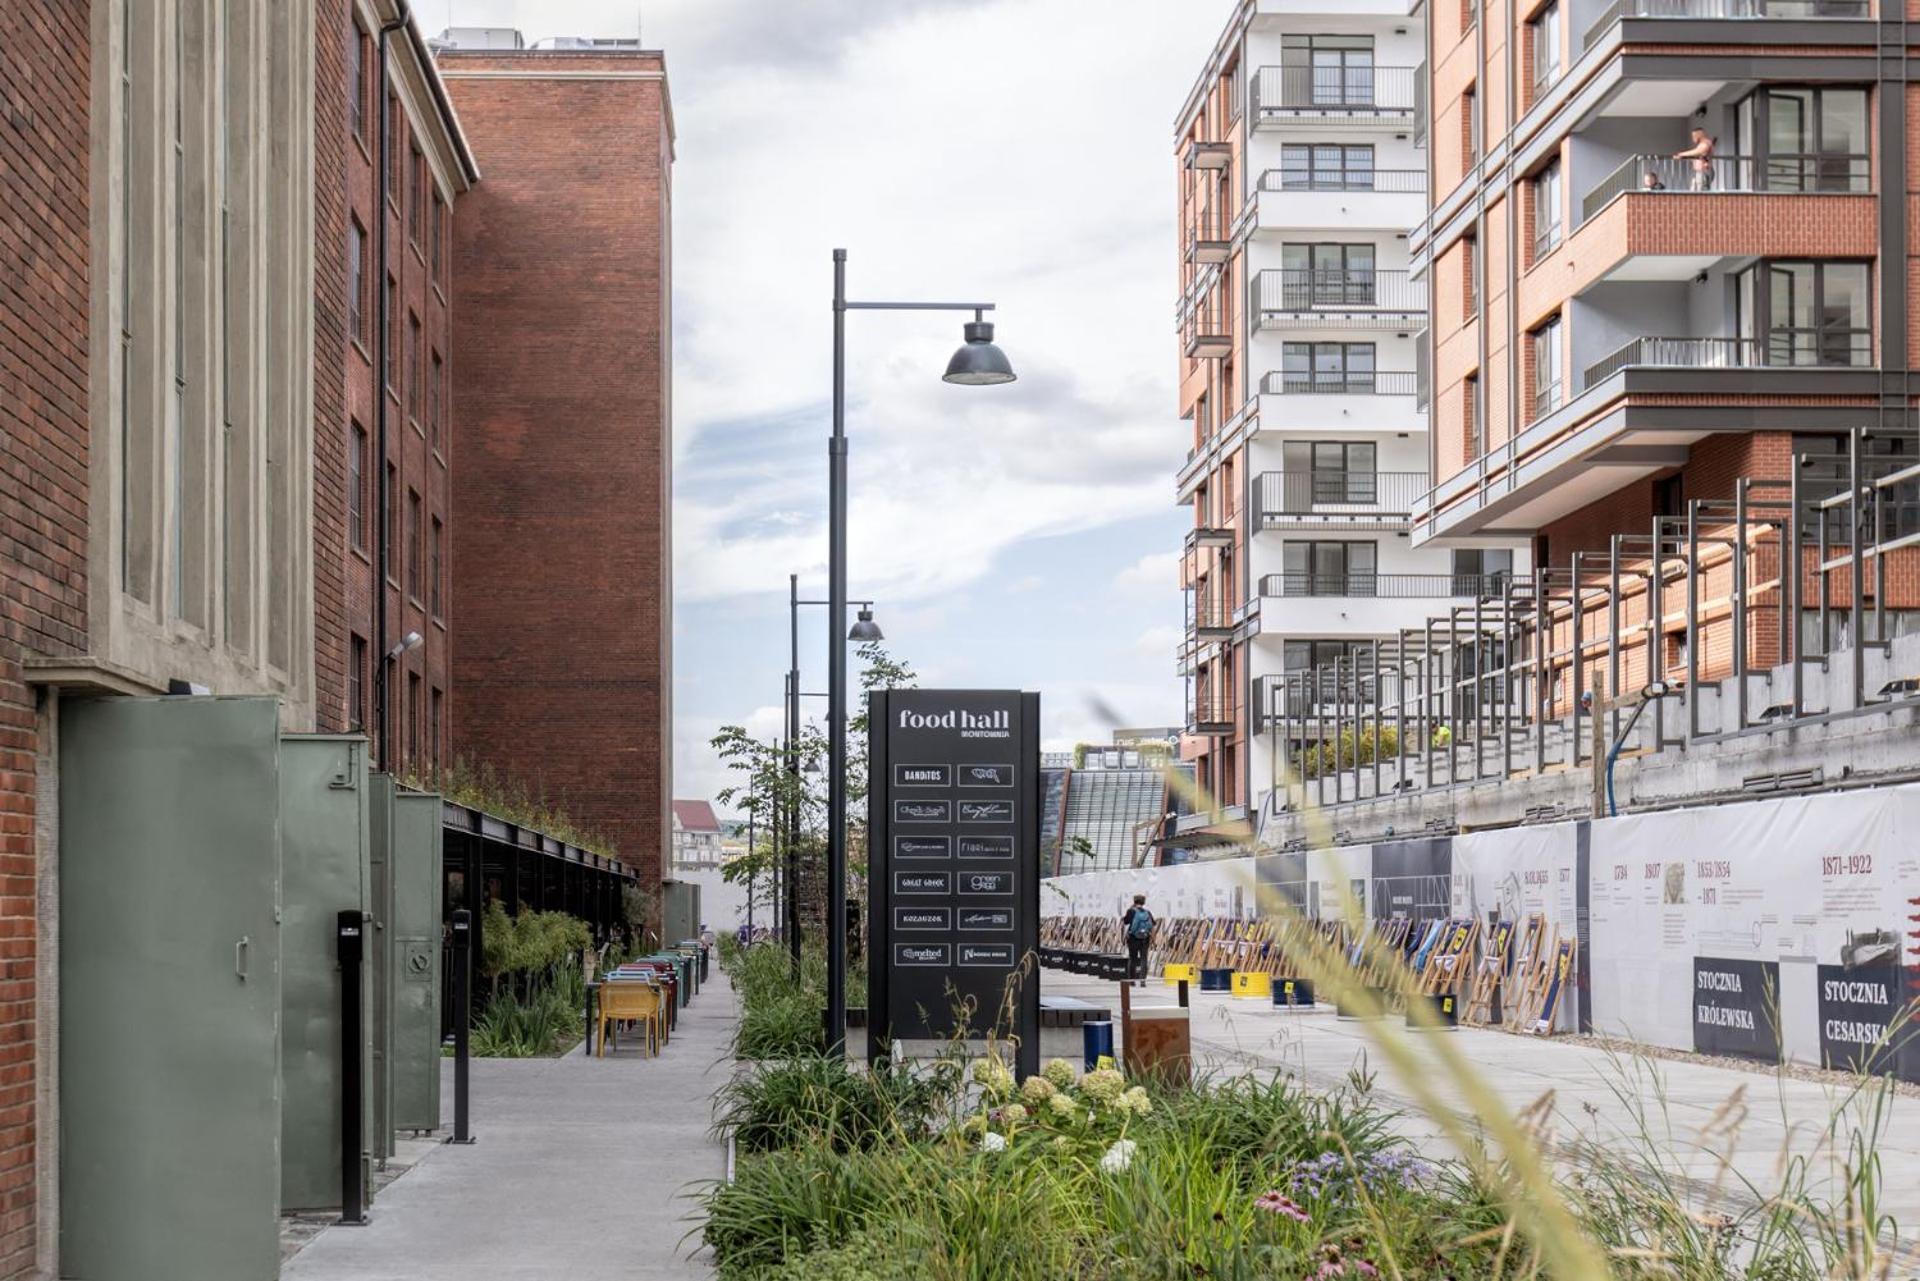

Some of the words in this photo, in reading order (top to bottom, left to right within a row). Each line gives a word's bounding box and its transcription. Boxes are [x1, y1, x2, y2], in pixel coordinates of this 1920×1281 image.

[900, 710, 956, 728] food
[961, 710, 1009, 728] hall
[1697, 970, 1743, 994] STOCZNIA
[1824, 980, 1889, 1005] STOCZNIA
[1697, 1000, 1755, 1030] KRÓLEWSKA
[1826, 1019, 1891, 1046] CESARSKA
